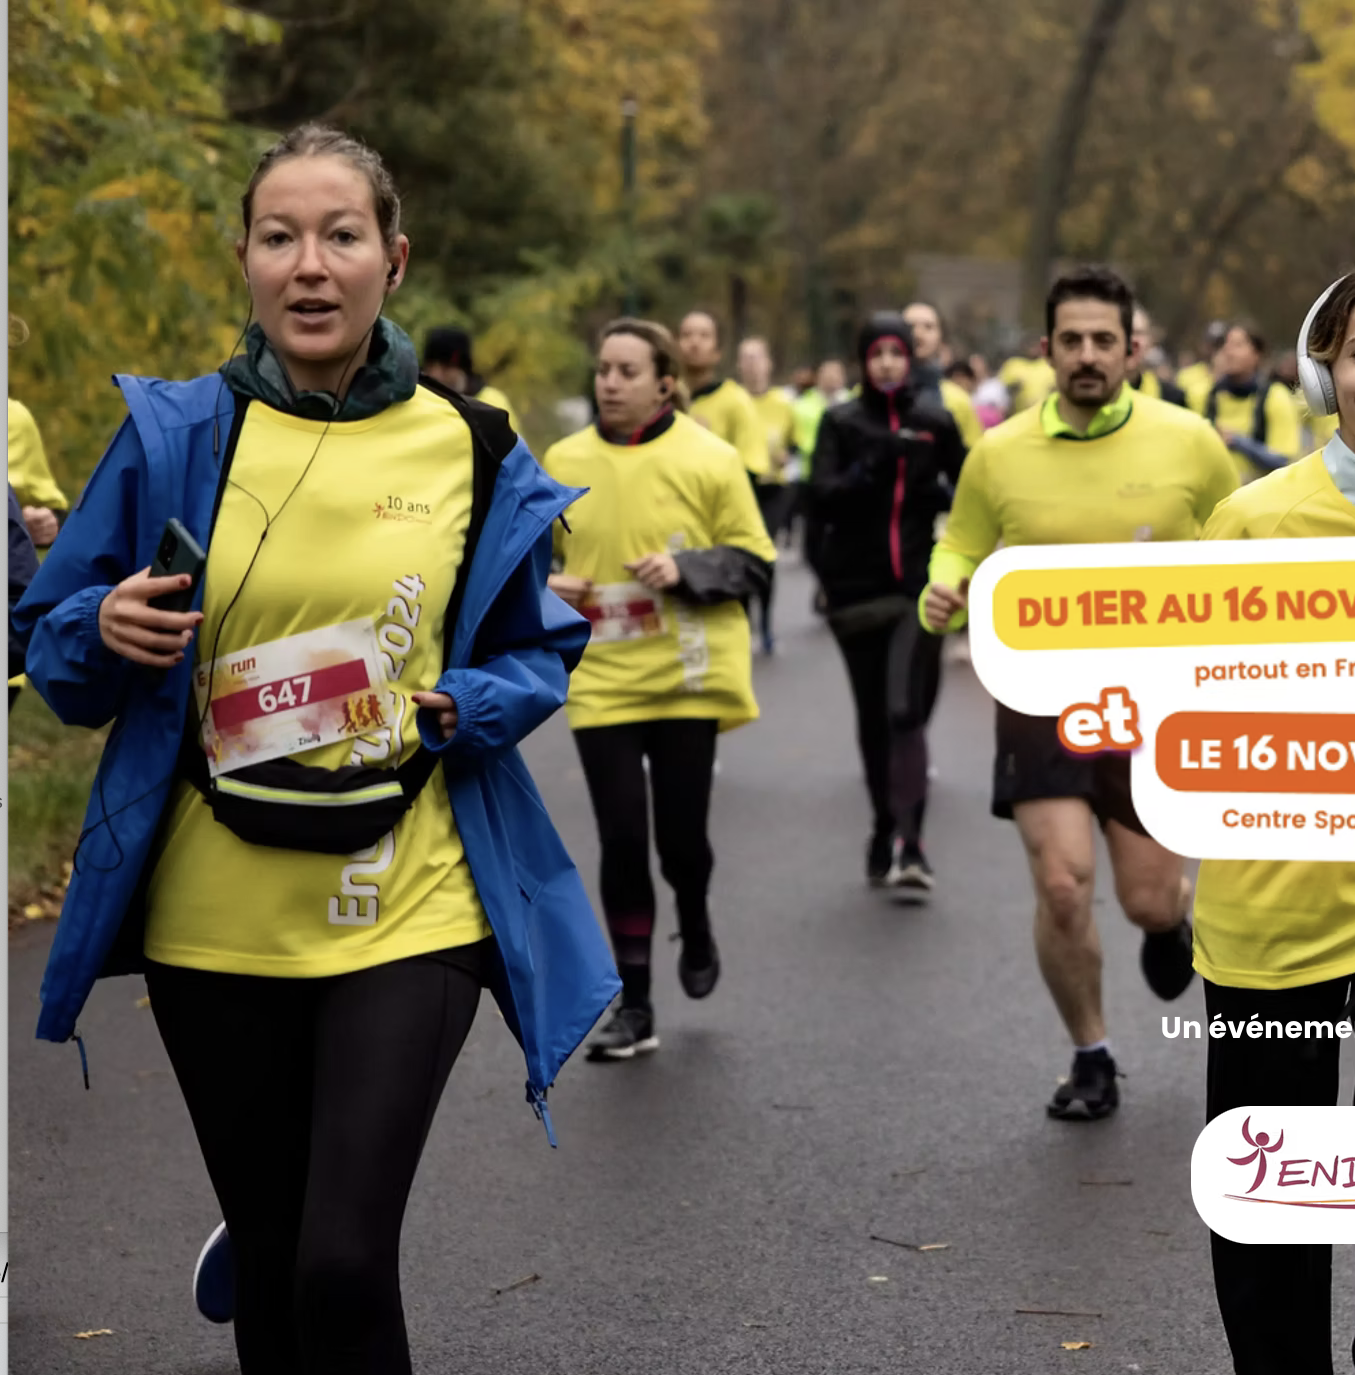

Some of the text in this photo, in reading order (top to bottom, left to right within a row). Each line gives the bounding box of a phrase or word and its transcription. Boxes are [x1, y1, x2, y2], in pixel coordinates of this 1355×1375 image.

[386, 495, 431, 515] 10 ans
[258, 675, 312, 713] 647
